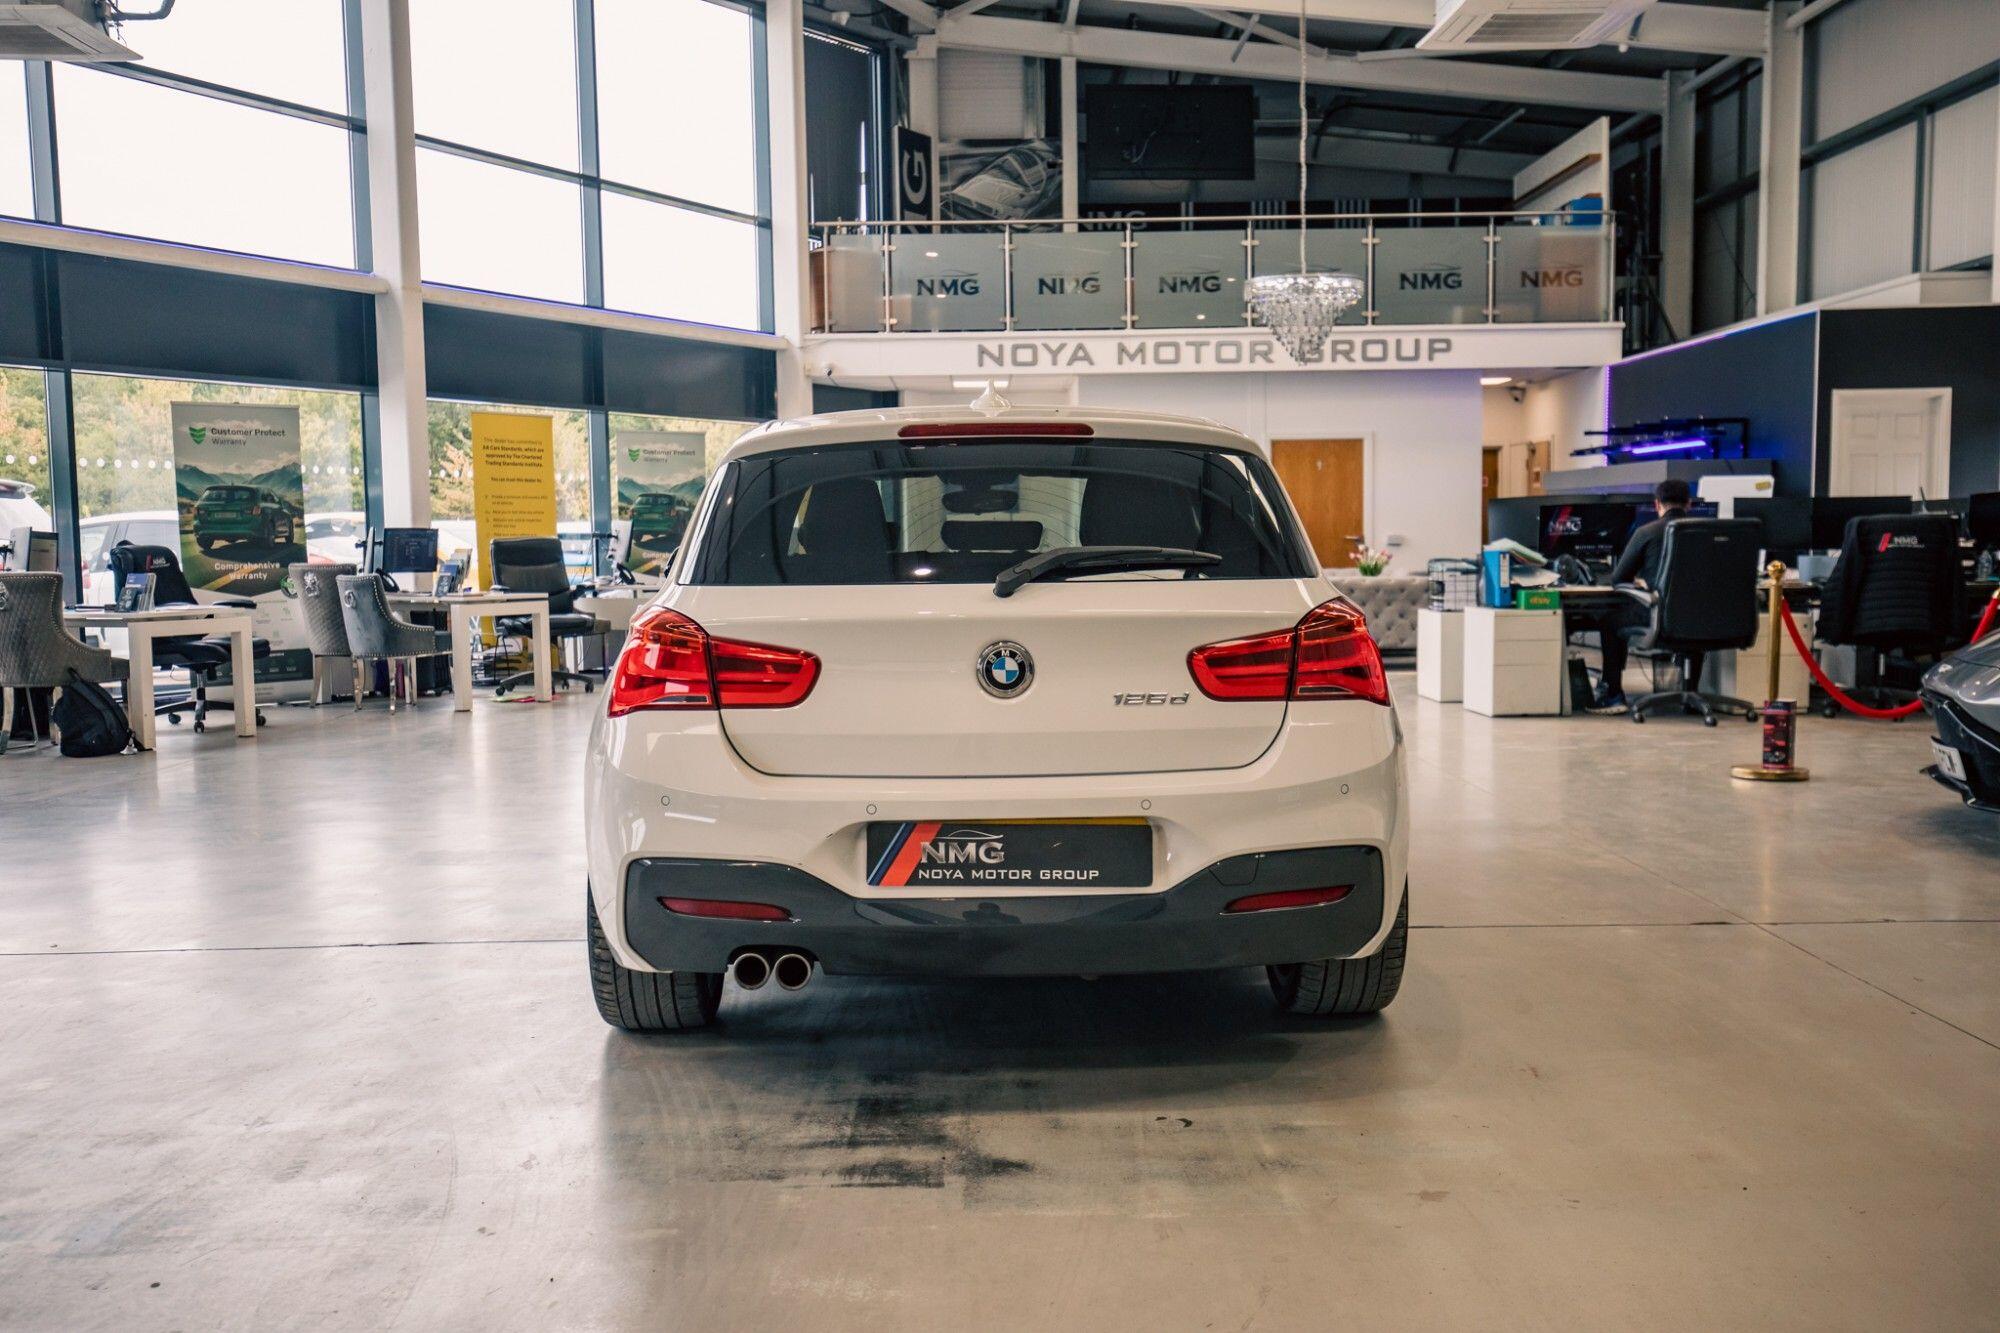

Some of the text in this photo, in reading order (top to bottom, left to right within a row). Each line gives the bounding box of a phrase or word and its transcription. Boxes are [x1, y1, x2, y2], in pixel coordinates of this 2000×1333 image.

[1158, 275, 1221, 293] NMG
[1399, 271, 1462, 290] NMG
[1520, 270, 1583, 288] NMG
[916, 278, 980, 296] NMG
[977, 343, 1095, 367] NOYA
[1117, 340, 1274, 366] MOTOR
[211, 427, 286, 437] Customer Protect
[211, 438, 247, 446] Warranty
[1893, 535, 1918, 545] NMG
[214, 561, 281, 571] Comprehensive
[228, 571, 268, 580] Warranty
[920, 841, 1005, 865] NMG
[918, 869, 1099, 880] NOYA MOTOR GROUP
